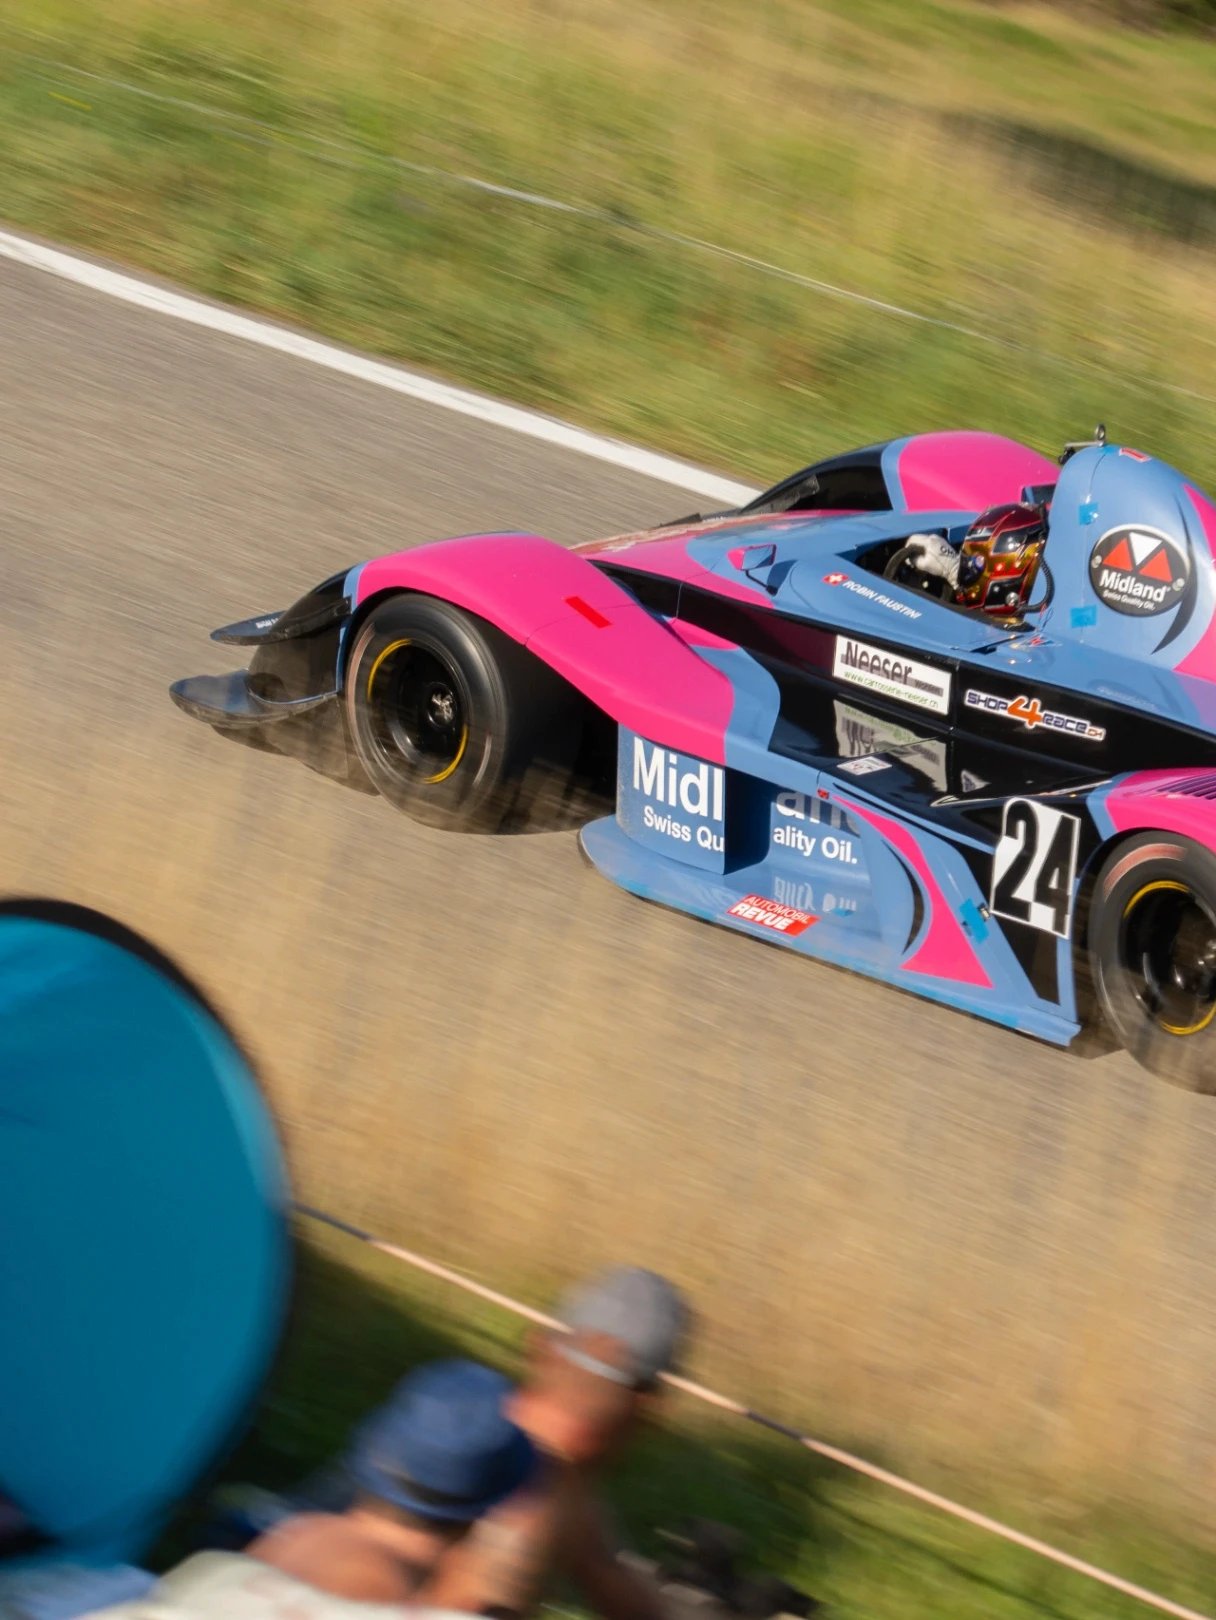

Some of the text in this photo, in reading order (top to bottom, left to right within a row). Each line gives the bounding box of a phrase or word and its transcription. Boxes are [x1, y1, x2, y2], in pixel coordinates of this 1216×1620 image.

[843, 580, 922, 619] ROBIN FAUSTINI
[1100, 569, 1165, 602] Midland
[1103, 589, 1122, 602] Swiss
[1121, 594, 1145, 609] Quality
[845, 641, 912, 685] Neeser
[643, 805, 858, 864] Swiss Qu ality Oil.
[994, 800, 1077, 935] 24
[730, 902, 796, 931] REVUE
[744, 896, 811, 924] AUTOMOBIL
